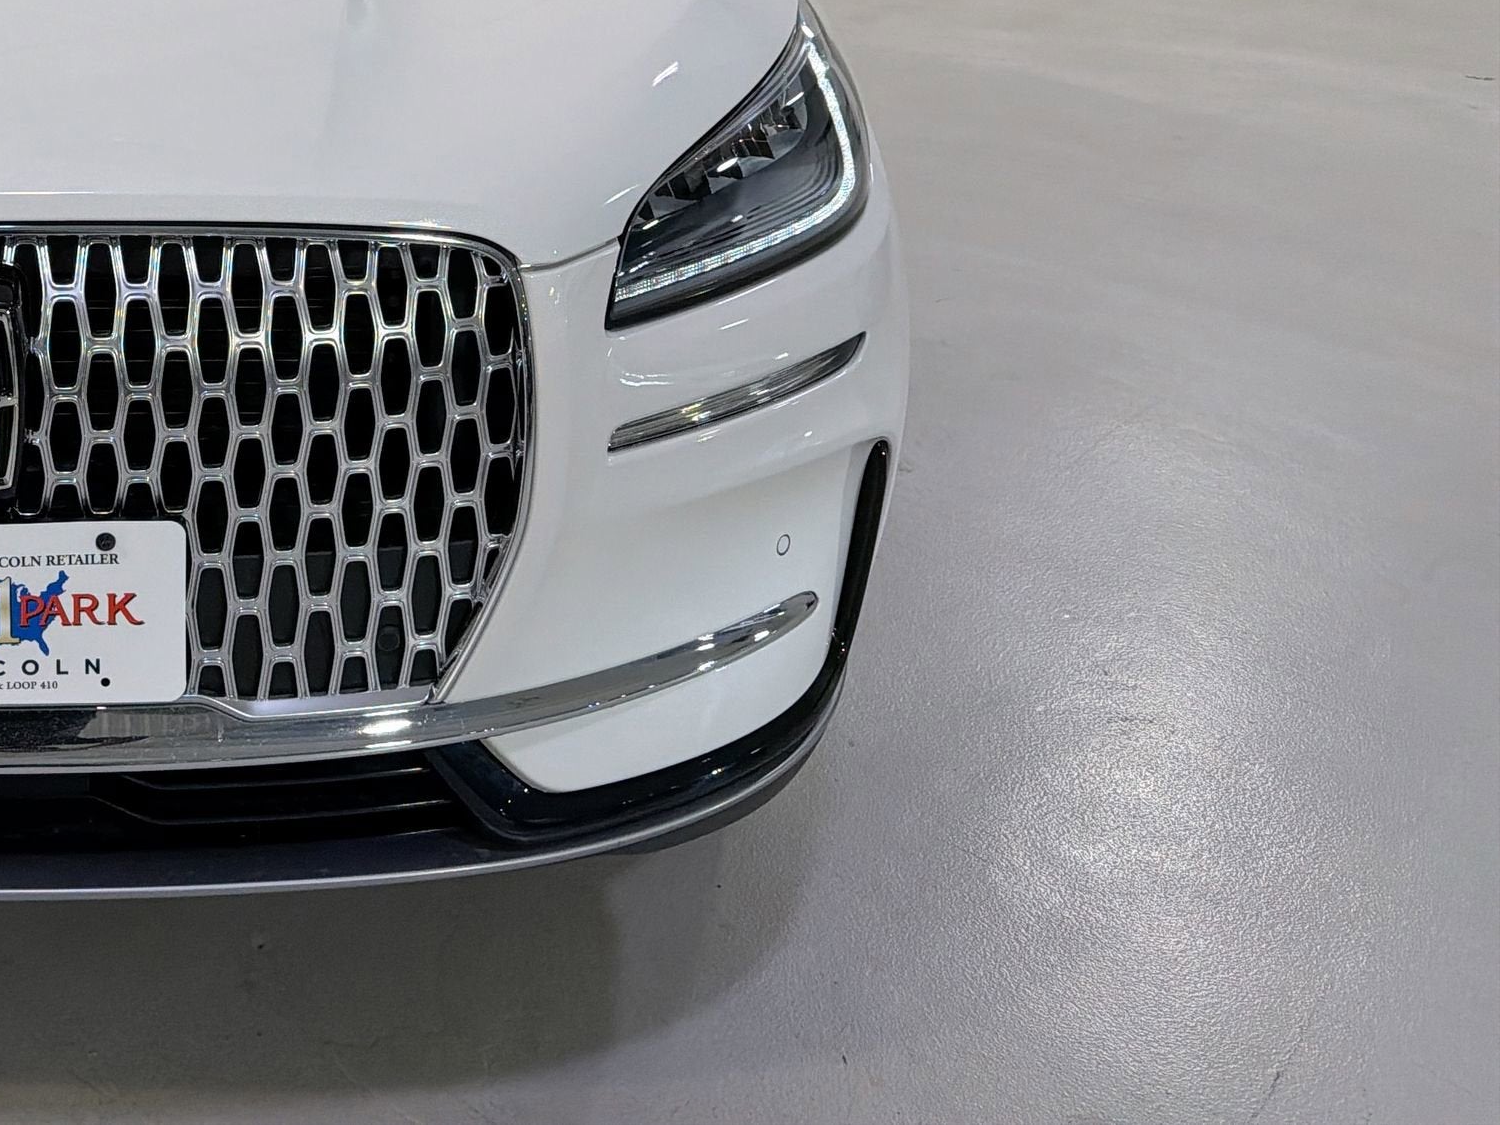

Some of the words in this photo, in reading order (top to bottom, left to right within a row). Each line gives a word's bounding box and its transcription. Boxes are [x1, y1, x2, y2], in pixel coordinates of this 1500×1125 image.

[45, 553, 120, 567] RETAILER
[19, 592, 145, 627] PARK
[6, 681, 38, 690] LOOP
[40, 680, 59, 690] 410
